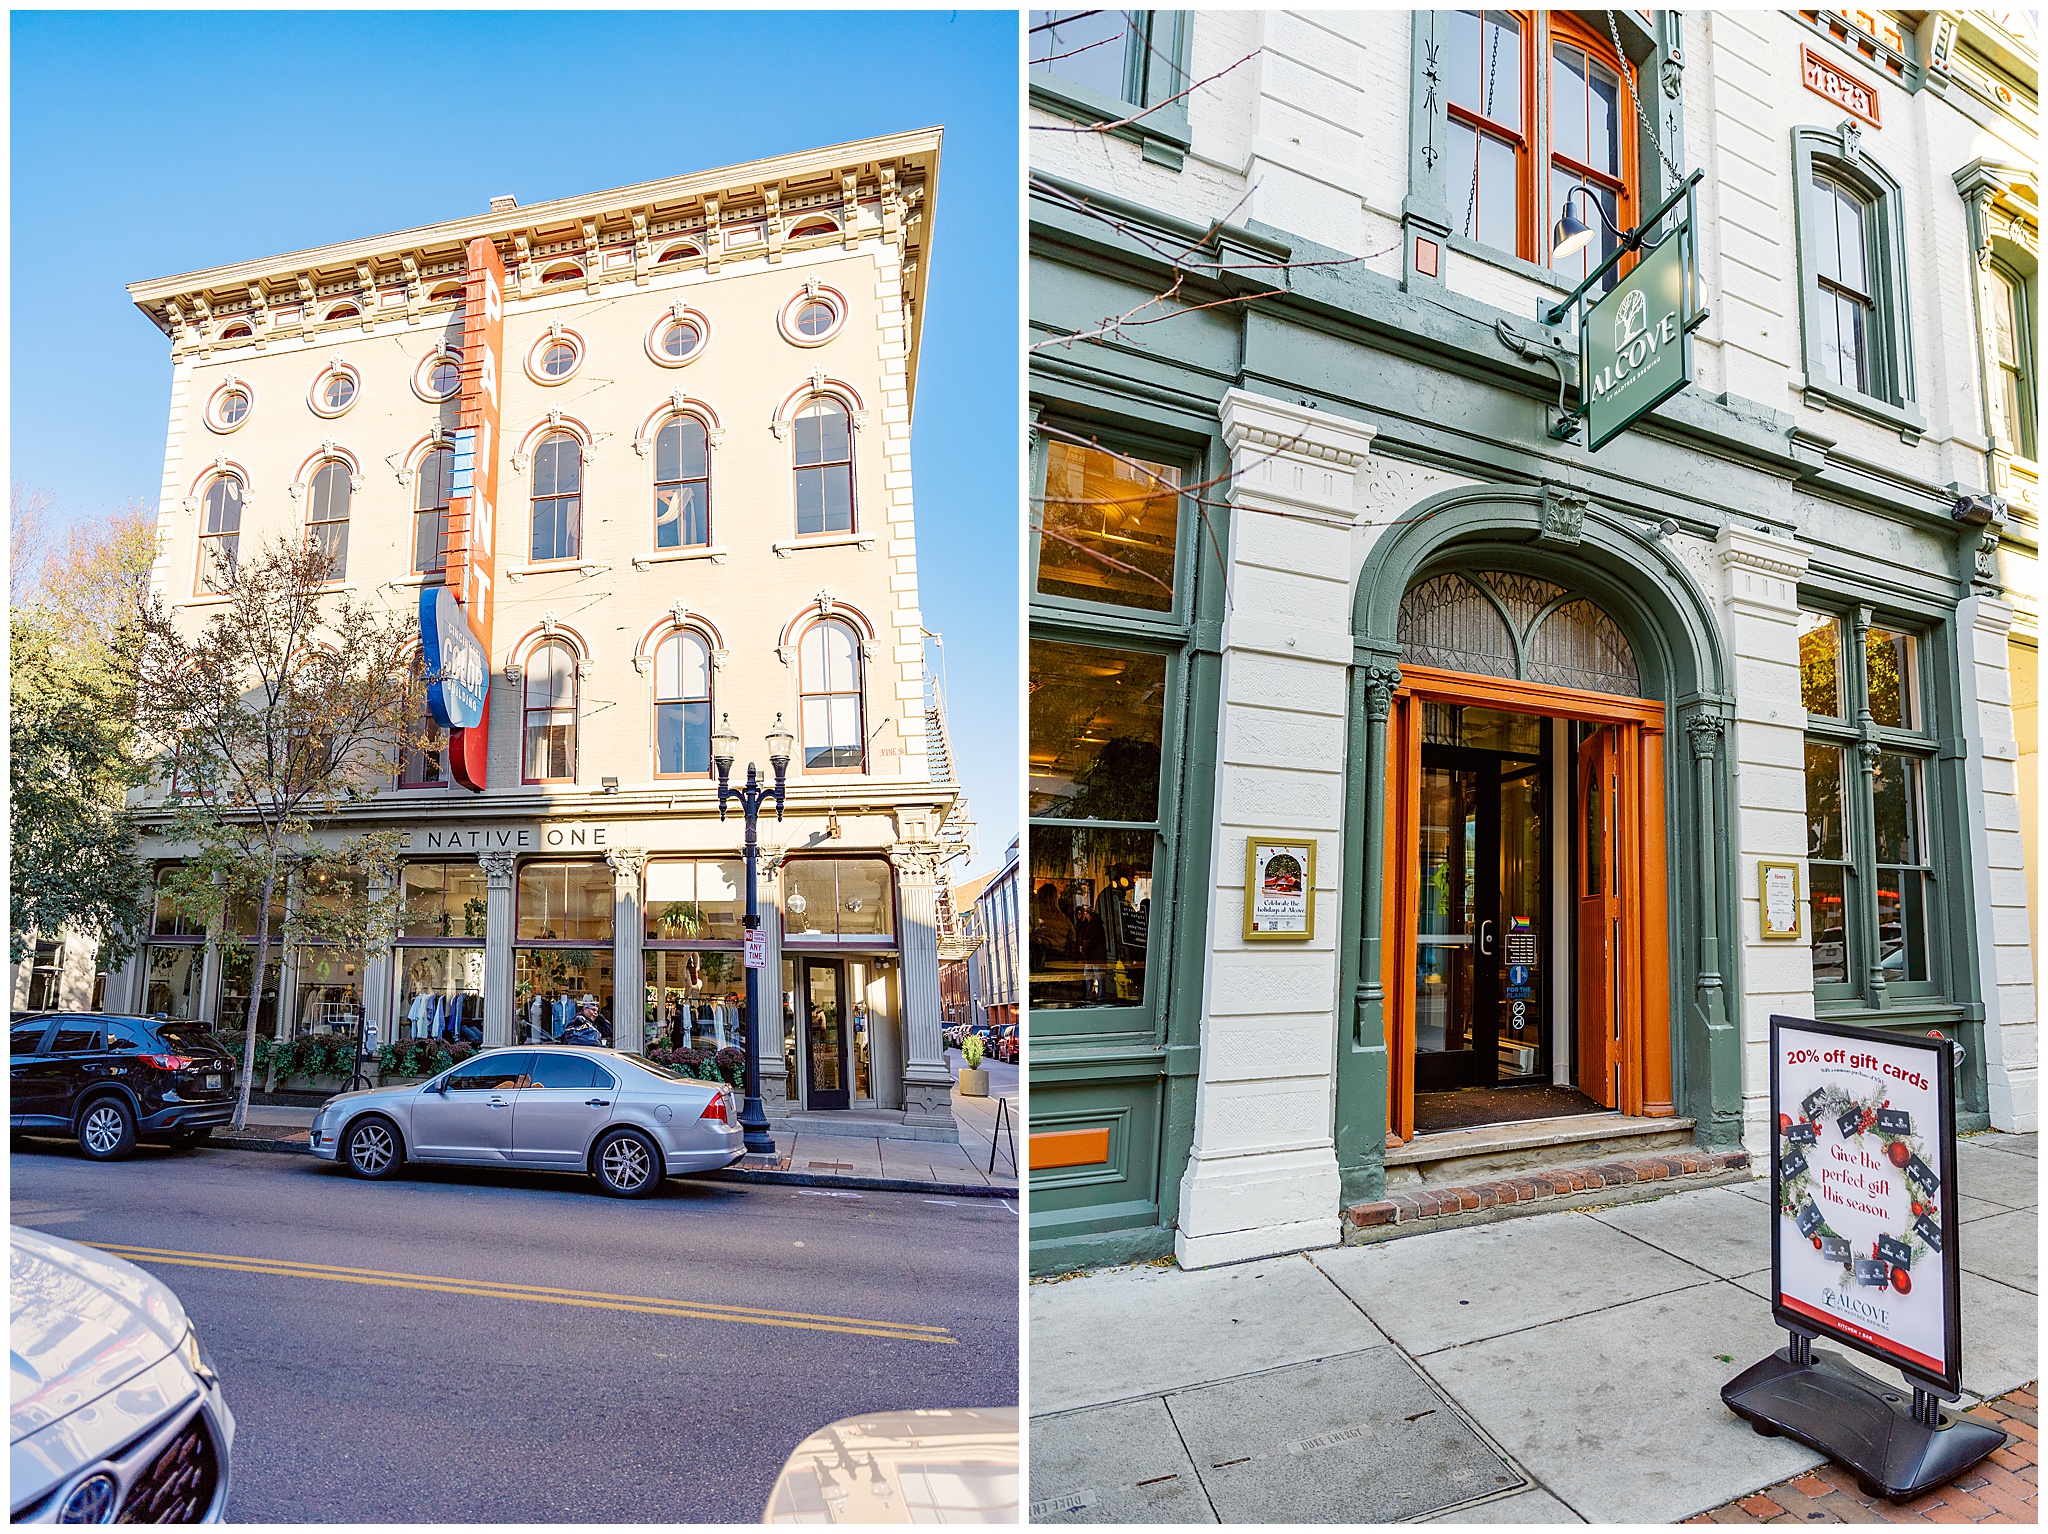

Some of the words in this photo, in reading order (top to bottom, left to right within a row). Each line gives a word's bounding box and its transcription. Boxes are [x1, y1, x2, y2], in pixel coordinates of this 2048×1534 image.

[1808, 63, 1868, 114] 1873
[1591, 311, 1676, 402] ALCOVE
[1606, 394, 1613, 402] BY
[1614, 375, 1636, 396] MADTREE
[1637, 356, 1661, 378] BREWING
[473, 266, 502, 625] PAINT
[443, 637, 483, 701] COLOR
[447, 679, 477, 712] BUILDING
[880, 747, 897, 757] VINE
[428, 830, 530, 848] NATIVE
[547, 828, 606, 846] ONE
[1257, 906, 1280, 914] holidays
[749, 952, 762, 960] TIME
[1515, 965, 1527, 984] 1%
[1786, 1049, 1820, 1065] 20%
[1823, 1049, 1846, 1064] off
[1849, 1053, 1878, 1071] gift
[1882, 1063, 1929, 1091] cards
[1830, 1143, 1858, 1165] Give
[1860, 1151, 1881, 1171] the
[1822, 1168, 1865, 1190] perfect
[1868, 1179, 1891, 1199] gift
[1823, 1184, 1844, 1205] this
[1846, 1197, 1890, 1220] season.
[1837, 1293, 1889, 1325] ALCOVE
[1844, 1309, 1866, 1322] MADTREE
[1866, 1318, 1890, 1331] BREWING
[1837, 1322, 1858, 1335] KITCHEN
[1862, 1332, 1873, 1341] BAR
[1300, 1436, 1327, 1451] DUKE
[1327, 1427, 1363, 1444] ENERGY
[1051, 1495, 1082, 1511] DUKE
